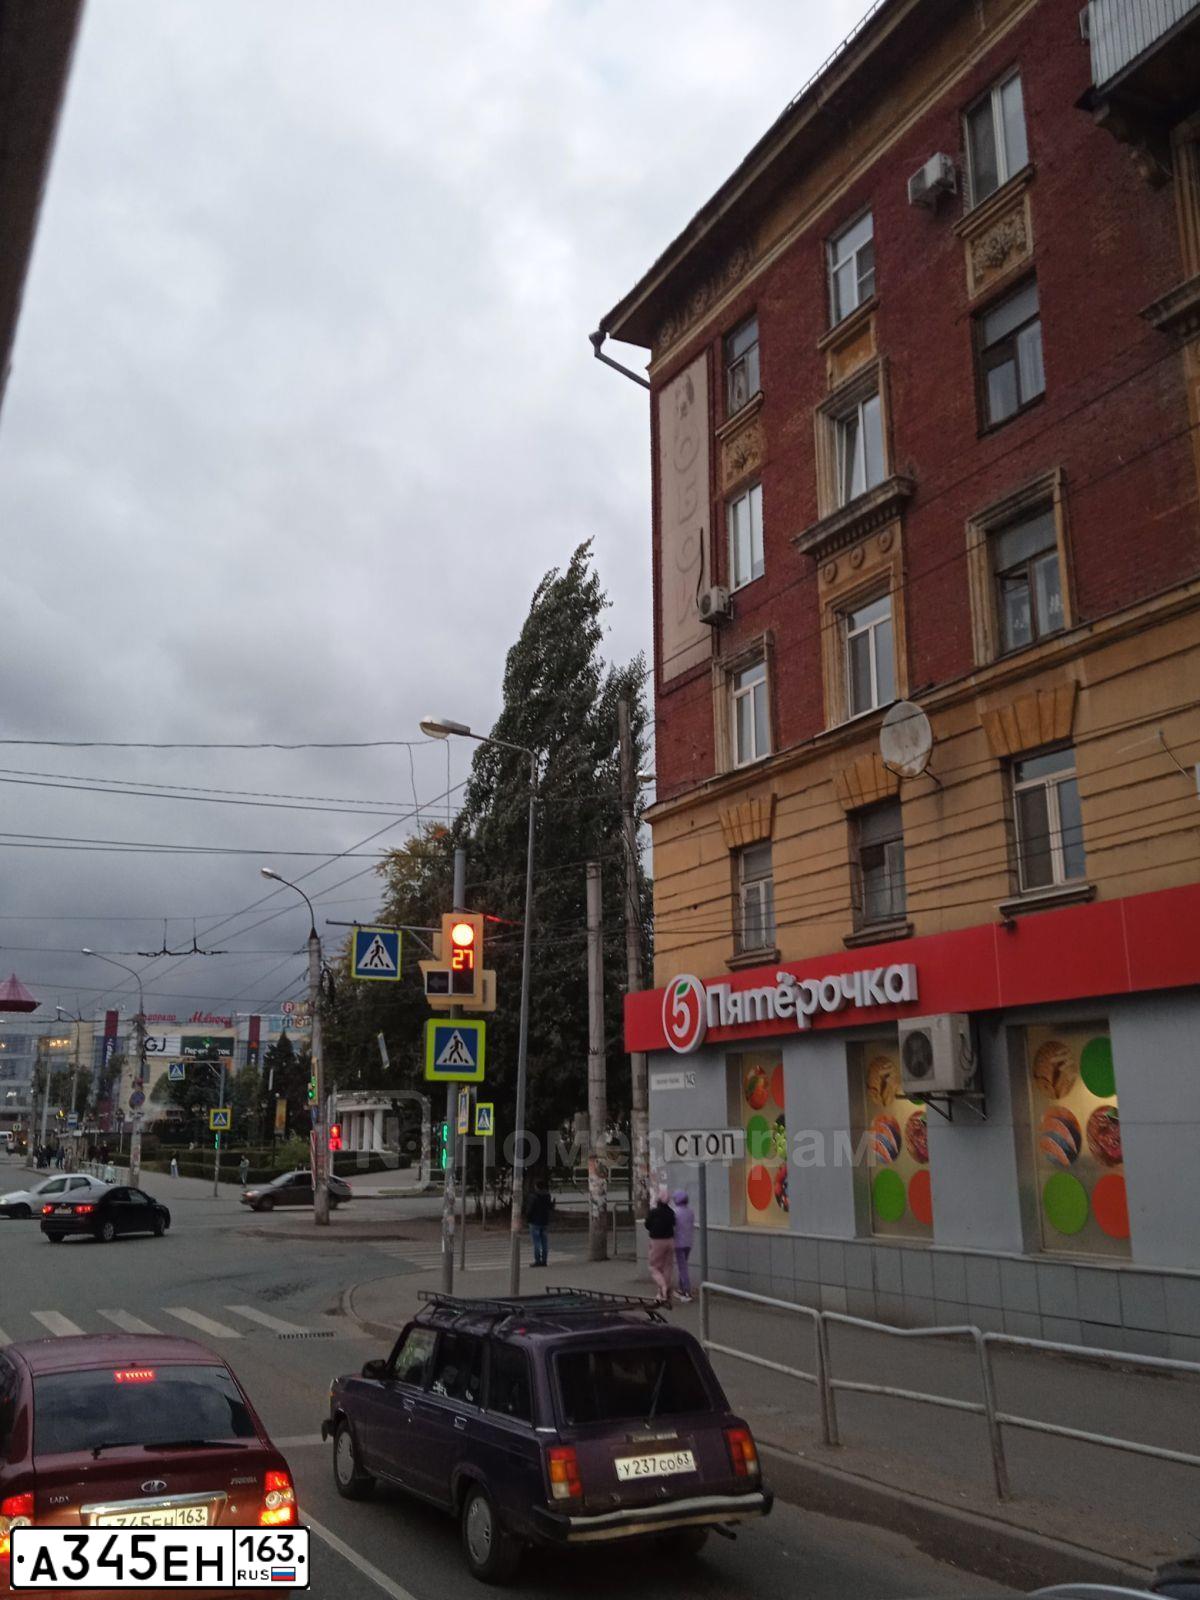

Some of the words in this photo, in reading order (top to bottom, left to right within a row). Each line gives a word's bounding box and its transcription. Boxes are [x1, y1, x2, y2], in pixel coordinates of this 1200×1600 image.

[452, 949, 474, 969] 27
[706, 963, 918, 1030] Пятёрочка
[675, 1133, 735, 1156] СТОП
